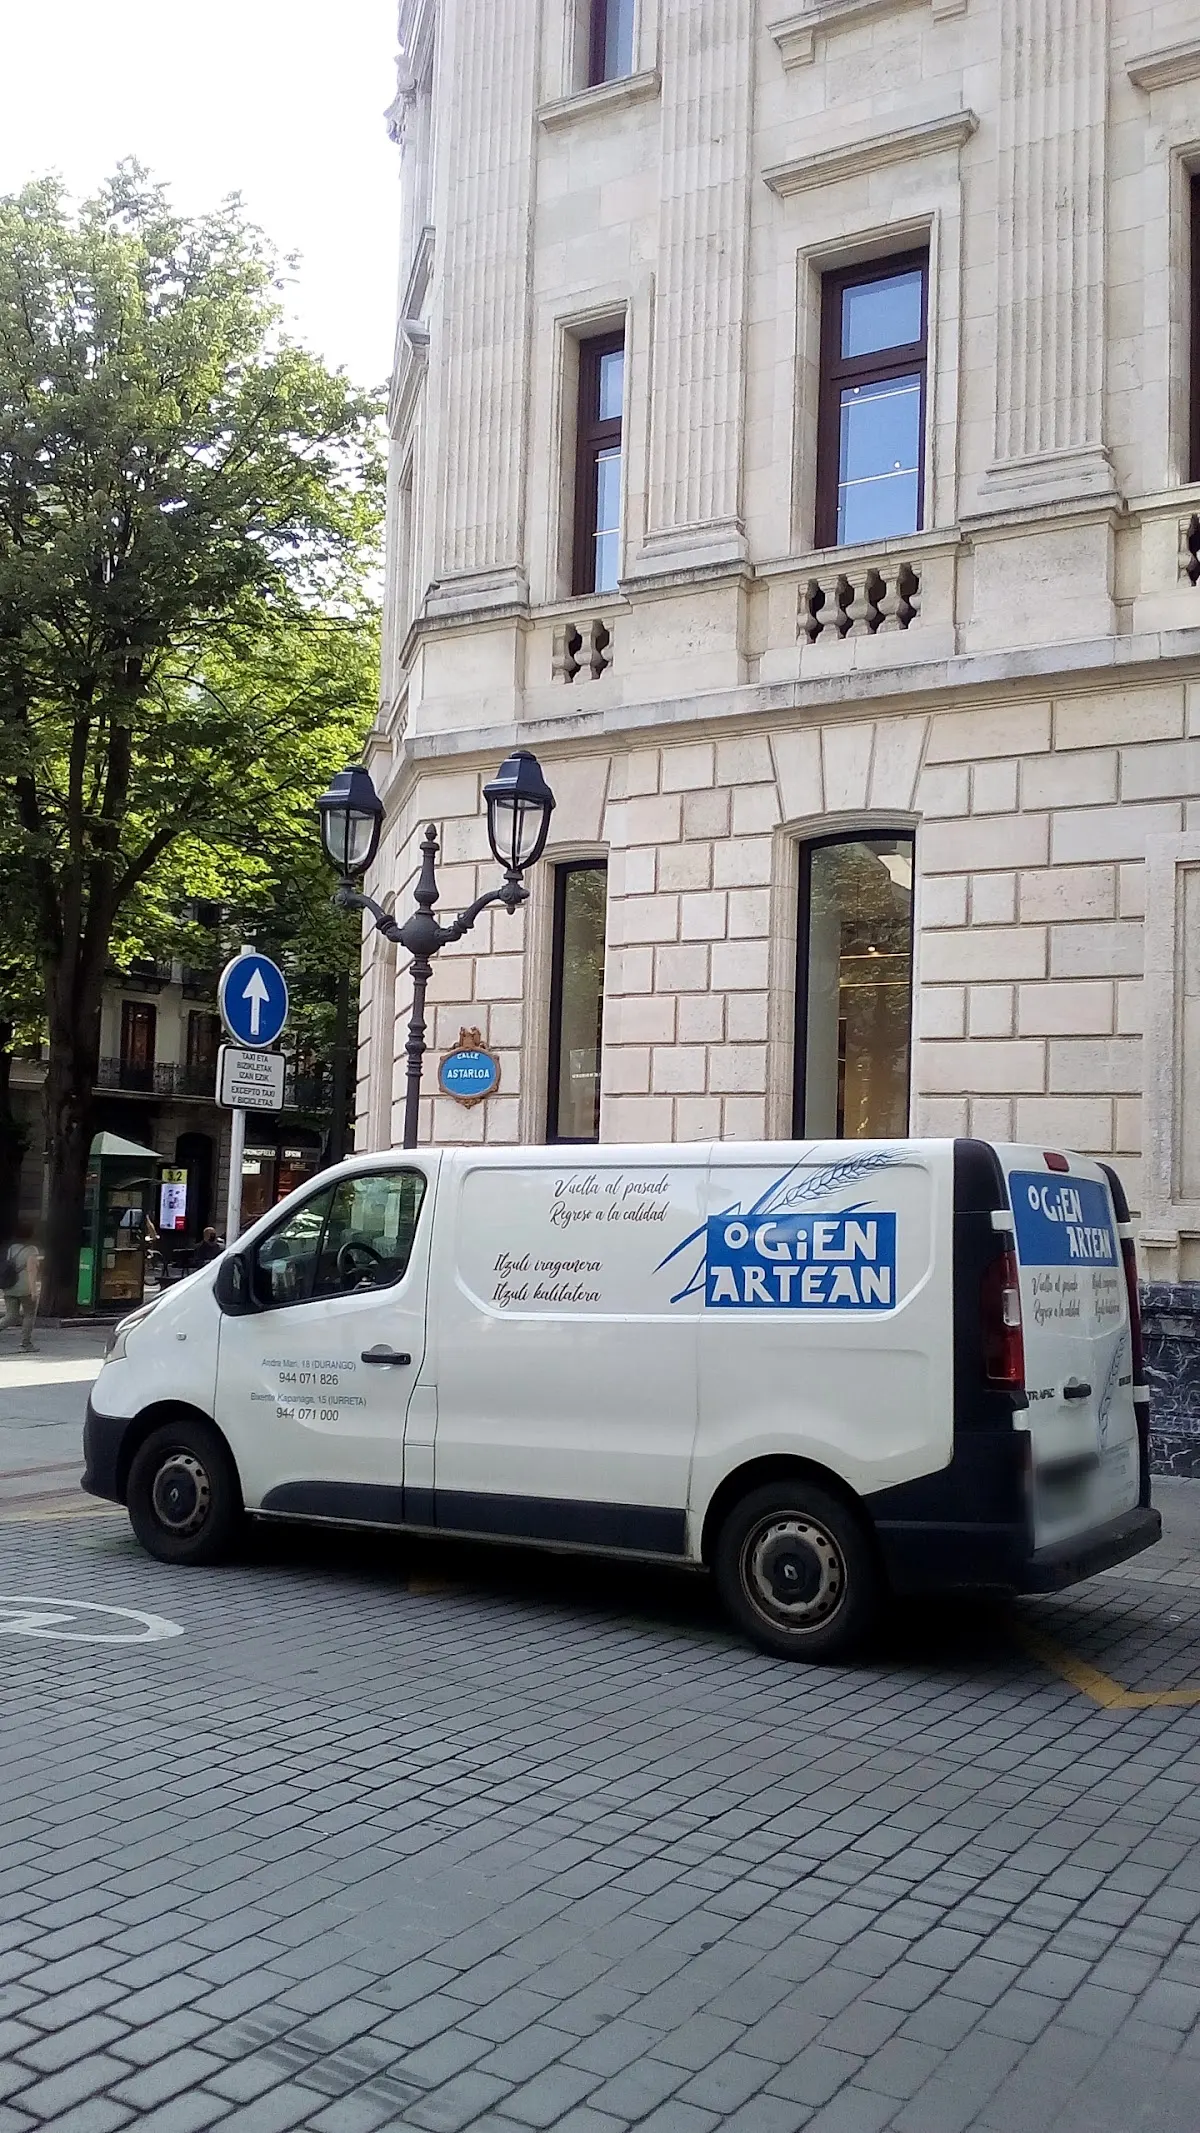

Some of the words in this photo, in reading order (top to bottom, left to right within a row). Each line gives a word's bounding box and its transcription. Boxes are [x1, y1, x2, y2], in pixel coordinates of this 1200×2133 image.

[242, 1053, 256, 1061] TAXI
[257, 1055, 269, 1063] ETA
[457, 1052, 479, 1060] CALLE
[447, 1069, 489, 1078] ASTARLOA
[231, 1086, 261, 1096] EXCEPTO
[262, 1089, 275, 1097] TAXI
[238, 1096, 274, 1107] BICICLETAS
[554, 1174, 601, 1197] Vuelta
[605, 1174, 624, 1195] al
[622, 1173, 670, 1201] pasado
[549, 1200, 593, 1229] Regreso
[596, 1210, 605, 1221] a
[607, 1202, 621, 1221] la
[623, 1201, 670, 1221] calidad
[1066, 1225, 1112, 1259] ARTEAN
[493, 1252, 530, 1278] Itzuli
[533, 1258, 602, 1279] iraganera
[710, 1266, 891, 1304] ARTEAN
[491, 1281, 529, 1308] Itzuli
[533, 1282, 601, 1302] kalitatera
[312, 1360, 356, 1371] (DURANGO)
[279, 1372, 297, 1383] 944
[299, 1373, 316, 1385] 071
[320, 1374, 339, 1386] 826
[318, 1395, 327, 1404] 15
[328, 1396, 367, 1406] (IURRETA)
[276, 1407, 295, 1419] 944
[298, 1408, 316, 1420] 071
[320, 1410, 339, 1421] 000
